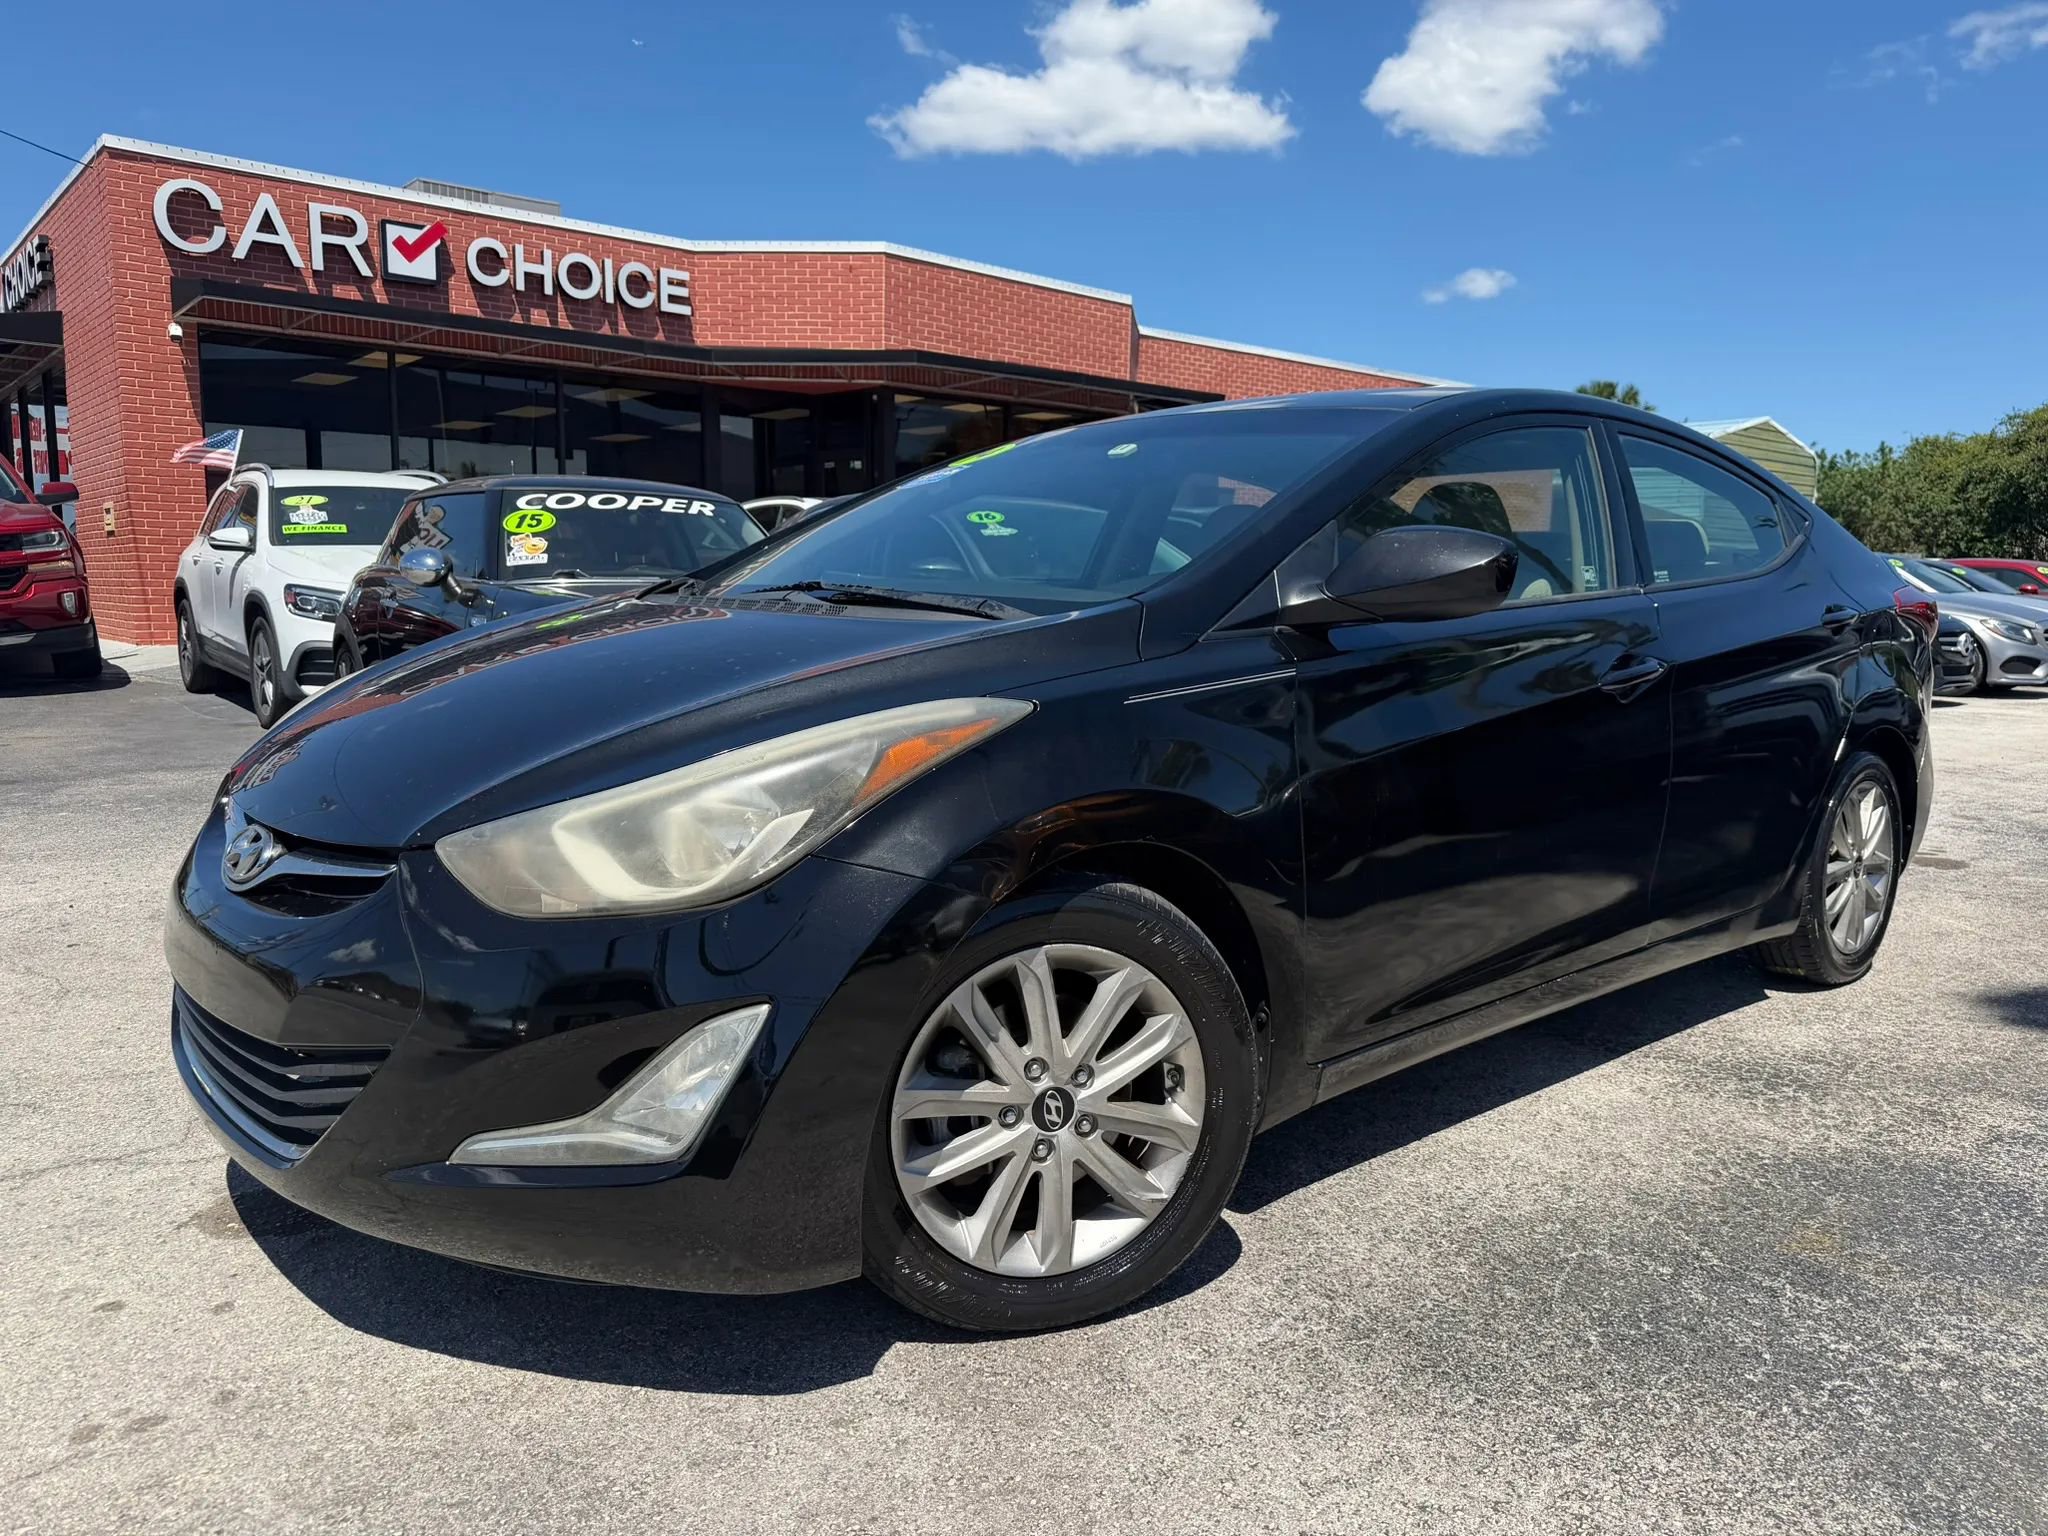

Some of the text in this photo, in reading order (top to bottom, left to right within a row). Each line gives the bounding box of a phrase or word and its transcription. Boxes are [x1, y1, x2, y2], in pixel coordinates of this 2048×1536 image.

[153, 178, 692, 316] CAR CHOICE
[5, 234, 48, 311] CHOICE
[515, 492, 716, 516] COOPER
[515, 513, 544, 529] 15
